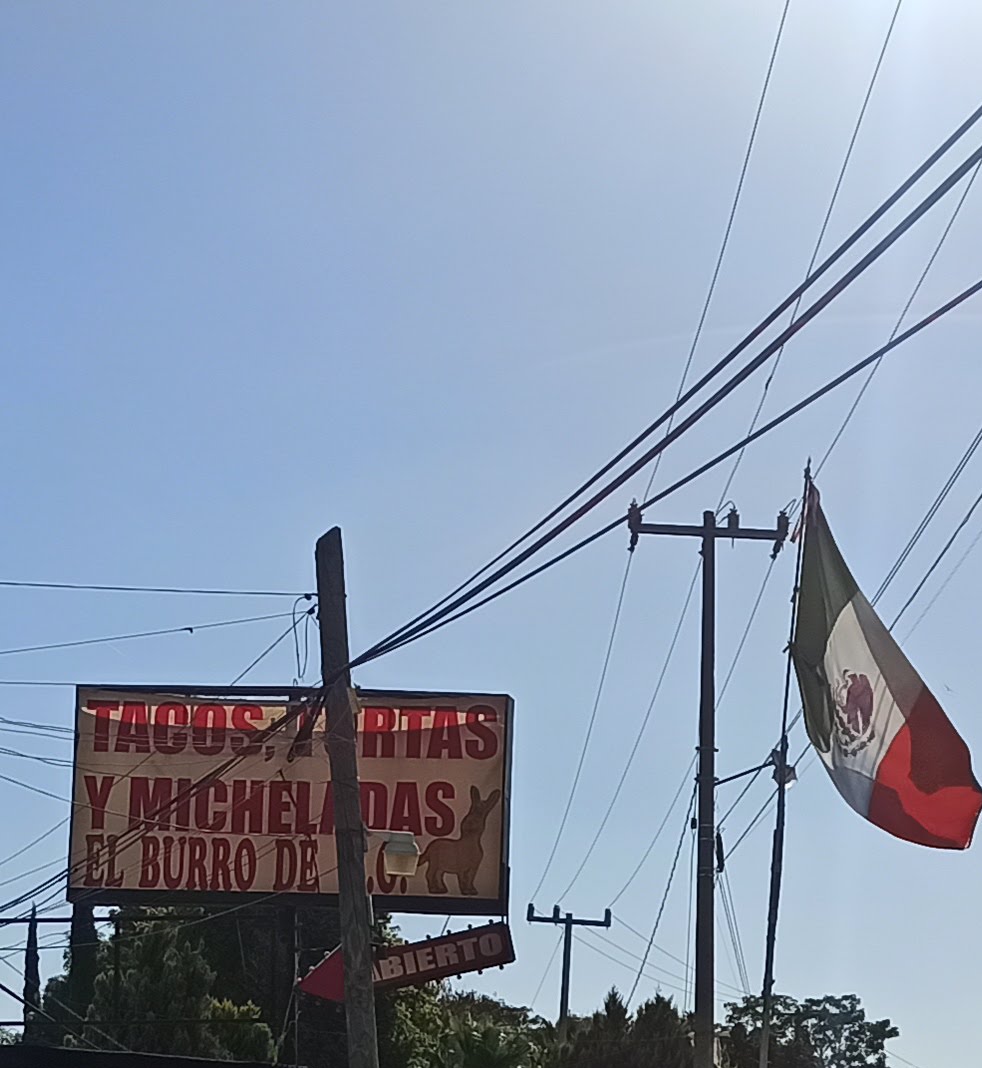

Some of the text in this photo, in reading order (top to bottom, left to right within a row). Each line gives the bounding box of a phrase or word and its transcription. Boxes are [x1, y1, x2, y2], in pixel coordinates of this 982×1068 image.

[87, 699, 499, 762] TACOS, TRTAS
[84, 775, 116, 829] Y
[83, 833, 125, 888] EL
[138, 835, 258, 891] BURRO
[273, 838, 319, 891] DE
